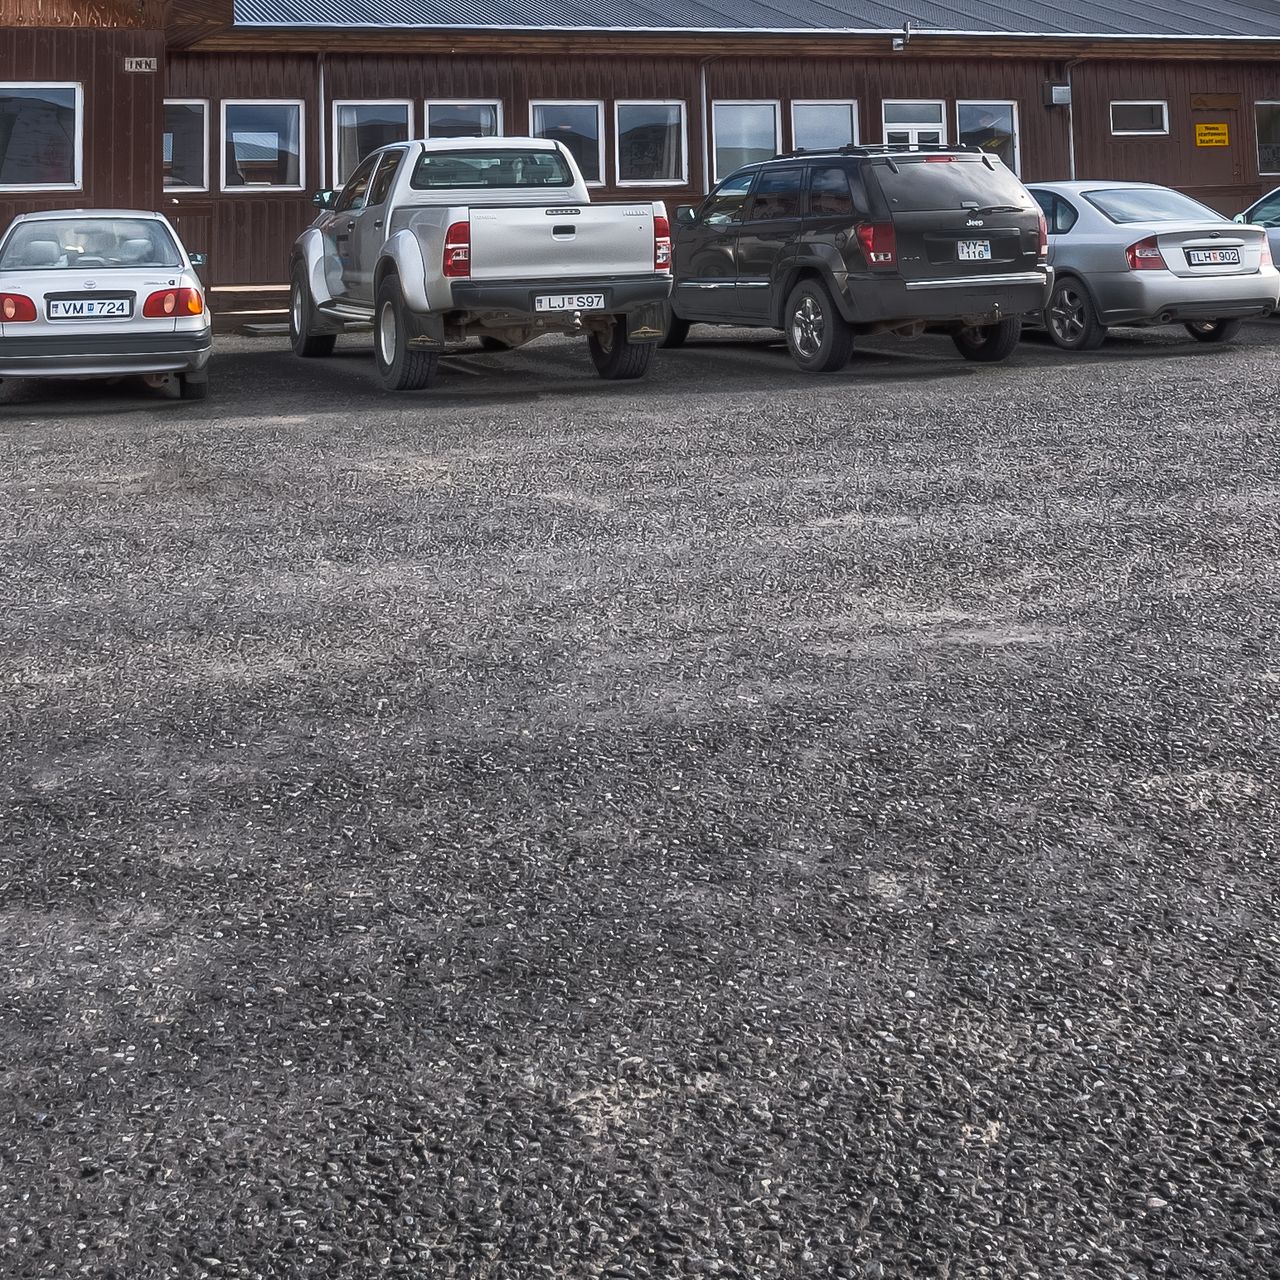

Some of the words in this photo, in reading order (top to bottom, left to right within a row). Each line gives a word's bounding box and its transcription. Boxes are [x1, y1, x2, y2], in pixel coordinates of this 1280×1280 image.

[129, 60, 152, 69] INN
[966, 219, 984, 227] Jeep
[966, 250, 985, 259] 116
[1197, 252, 1211, 262] LH
[1219, 251, 1237, 261] 902
[548, 297, 565, 309] LJ
[576, 296, 603, 308] S97
[63, 303, 84, 315] VM
[97, 302, 126, 314] 724
